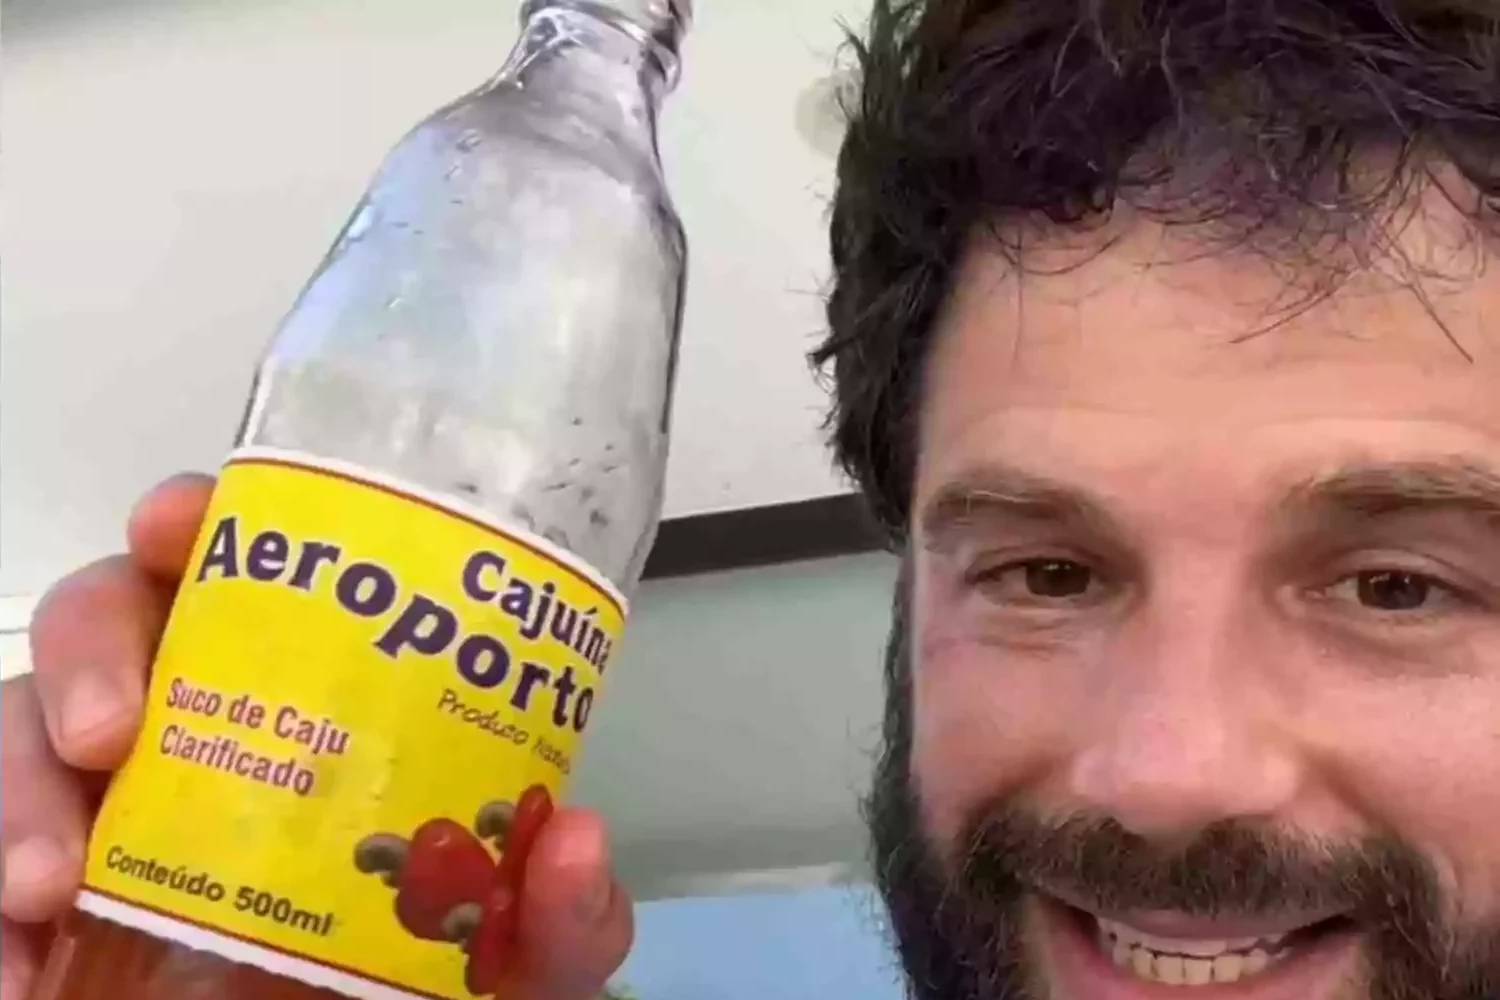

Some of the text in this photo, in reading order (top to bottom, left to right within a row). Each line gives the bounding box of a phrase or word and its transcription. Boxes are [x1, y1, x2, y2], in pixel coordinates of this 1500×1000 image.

[196, 515, 594, 733] Aeroporto
[166, 677, 349, 755] Suco de Caju
[160, 724, 315, 796] Clarificado
[106, 845, 334, 937] Conteúdo 500ml
